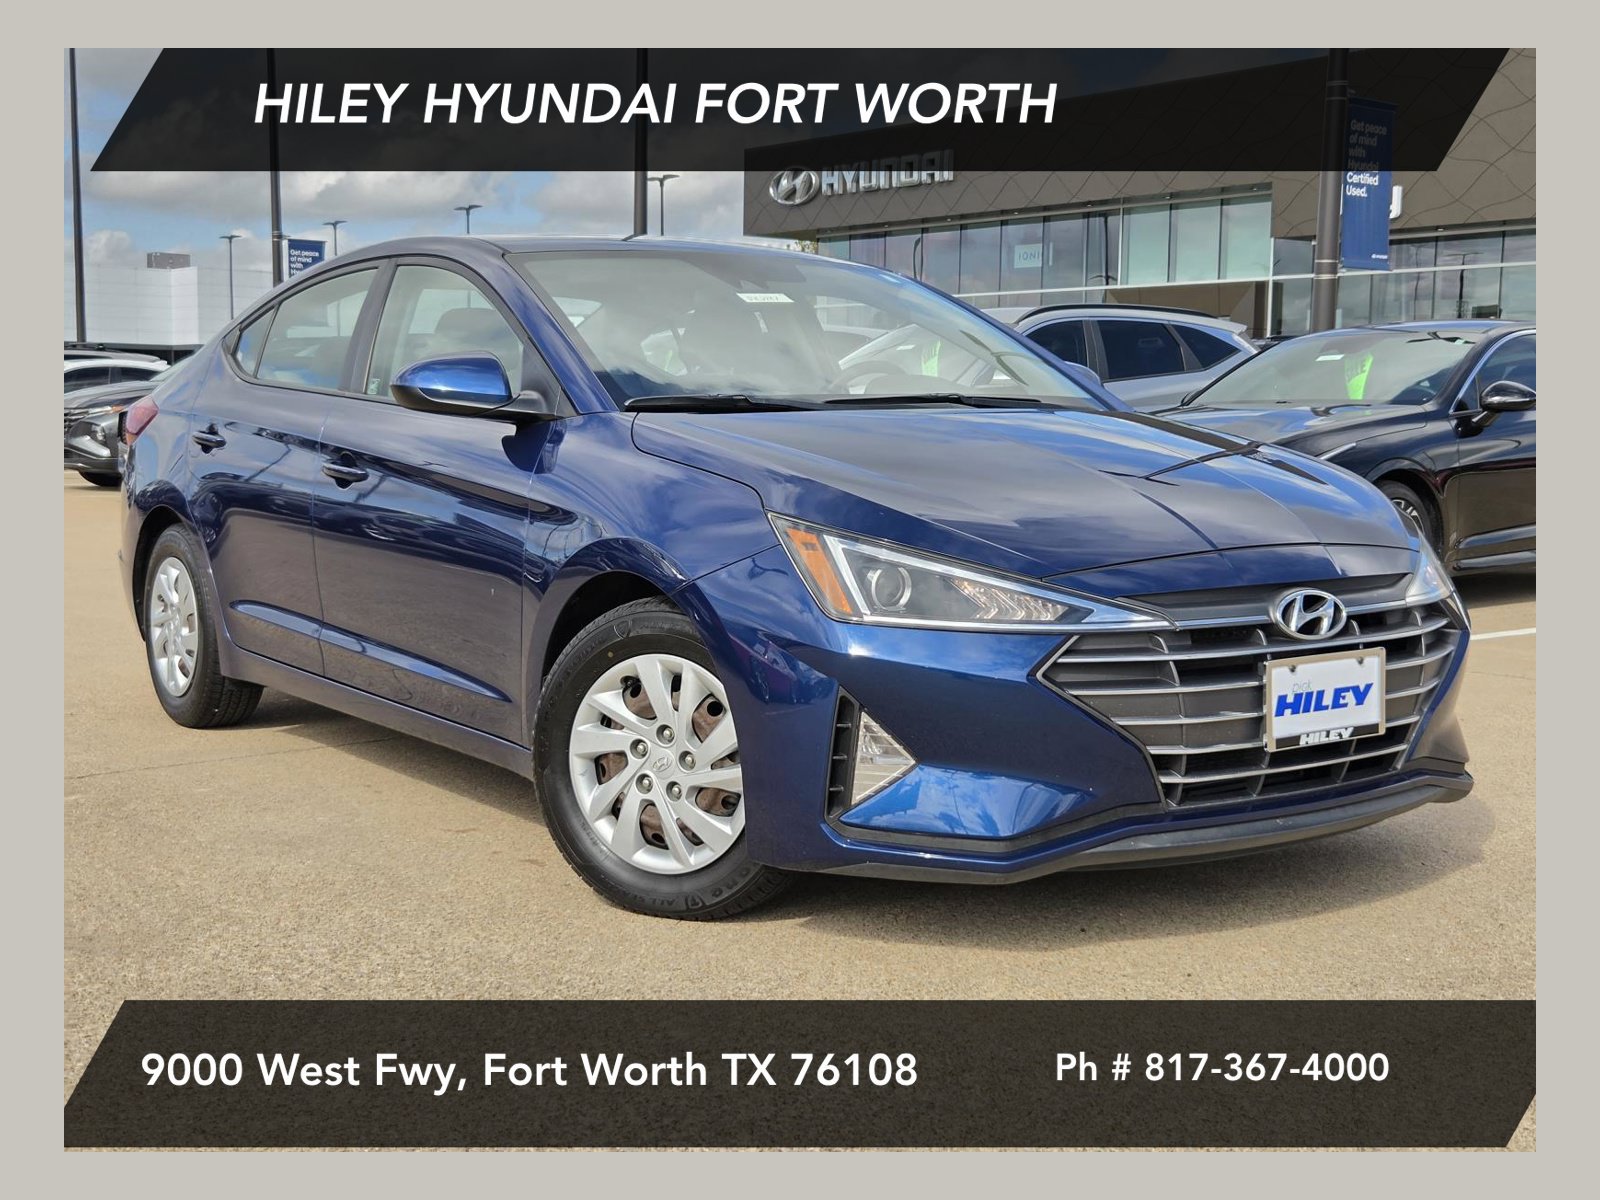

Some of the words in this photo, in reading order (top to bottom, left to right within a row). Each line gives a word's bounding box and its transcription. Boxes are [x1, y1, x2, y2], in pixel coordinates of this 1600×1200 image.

[1350, 119, 1365, 132] Get
[1358, 134, 1377, 147] mind
[1348, 145, 1366, 158] with
[821, 150, 954, 196] HYUNDAI
[1346, 172, 1379, 186] Certified
[1346, 185, 1367, 197] Used.
[1274, 683, 1374, 717] HILEY
[1299, 727, 1355, 746] HILEY
